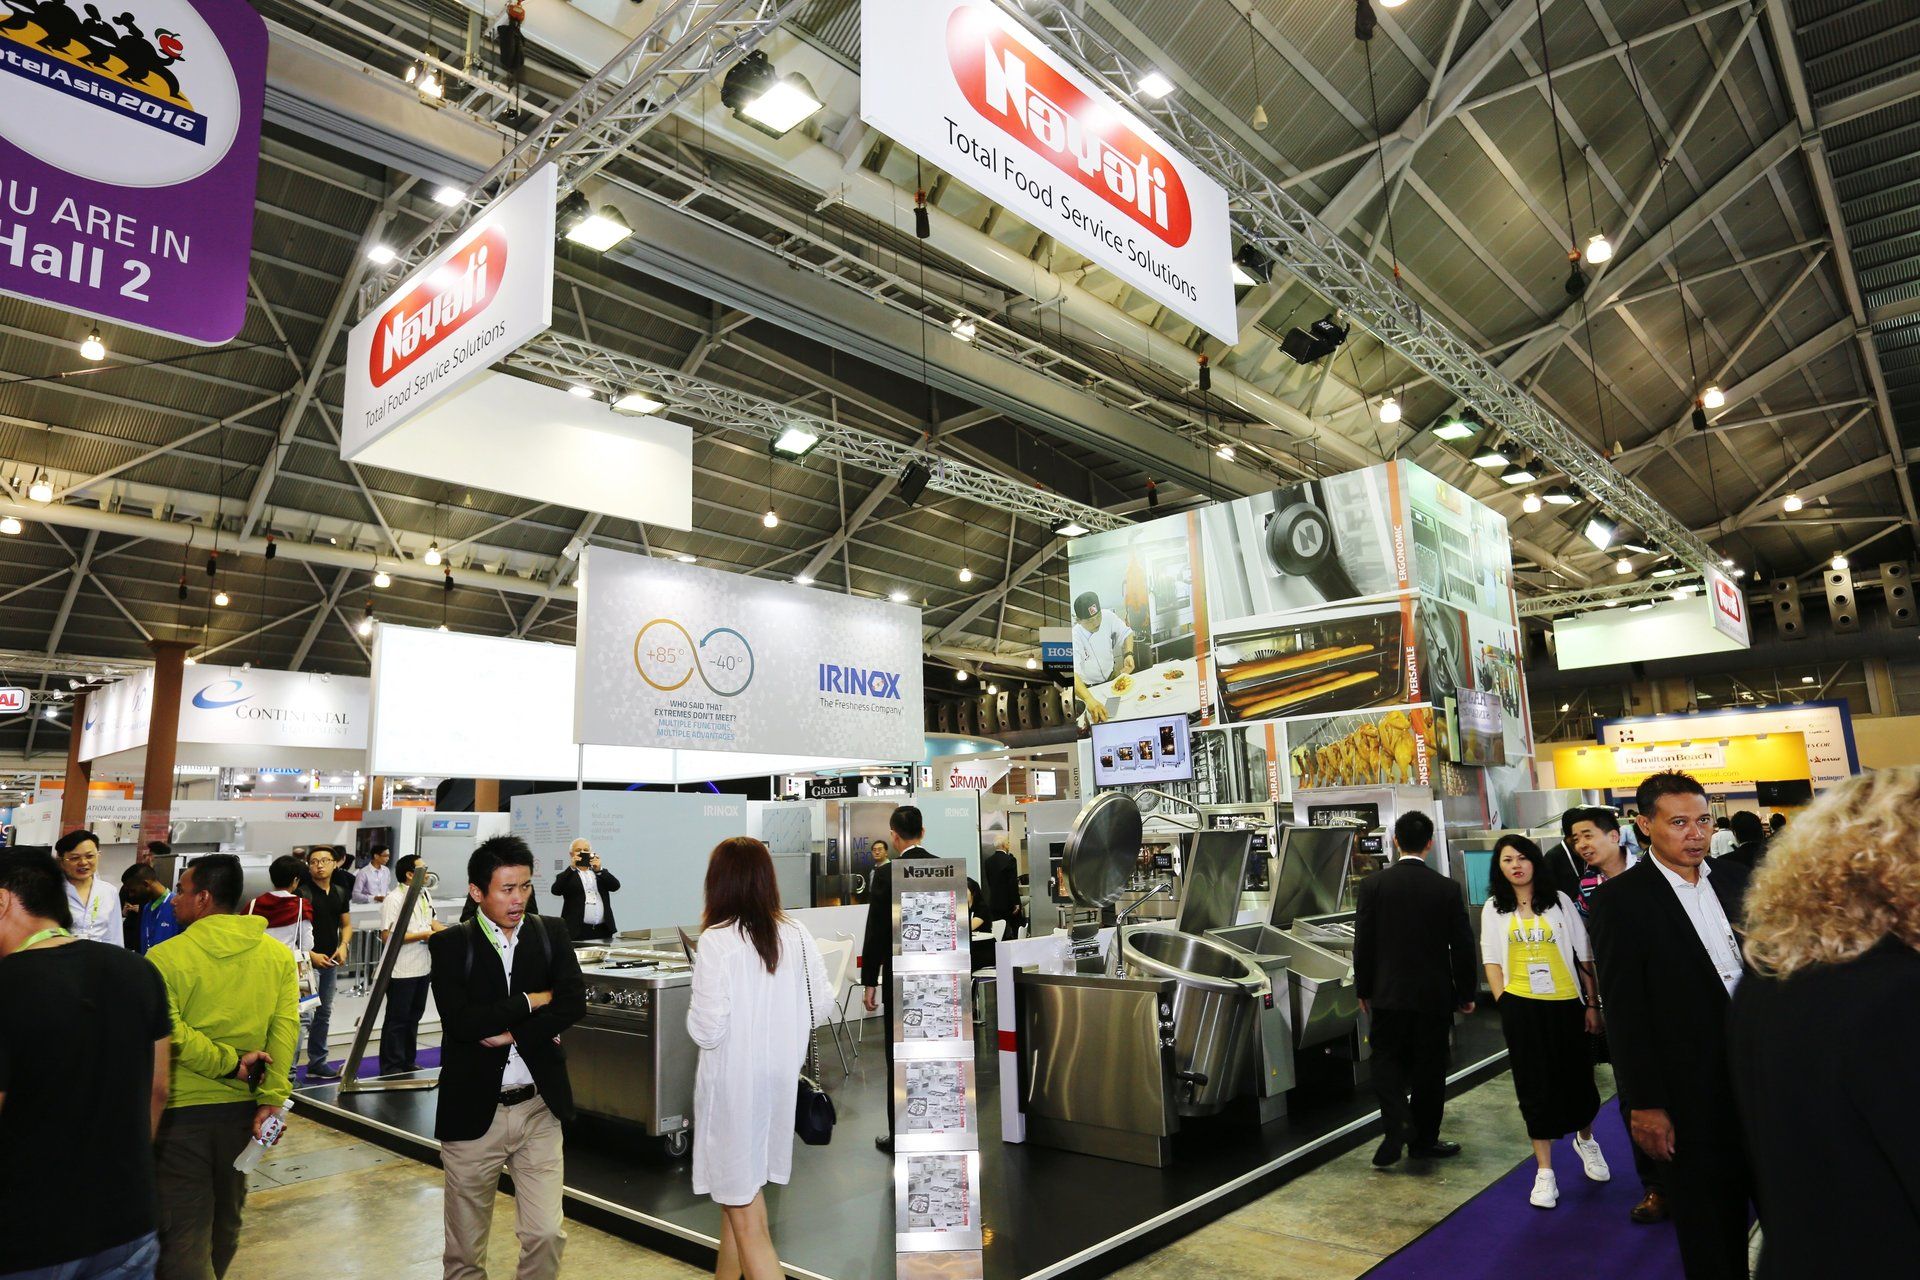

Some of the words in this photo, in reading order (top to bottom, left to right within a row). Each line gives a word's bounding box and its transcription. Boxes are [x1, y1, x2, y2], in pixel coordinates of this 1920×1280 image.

[0, 49, 196, 132] telAsia2016
[0, 178, 38, 215] U
[51, 197, 137, 247] ARE
[150, 225, 190, 264] IN
[944, 116, 996, 173] Total
[1004, 156, 1053, 209] Food
[1060, 195, 1123, 254] Service
[1127, 239, 1197, 302] Solutions
[0, 222, 104, 289] Hall
[119, 260, 151, 302] 2
[365, 404, 386, 429] Total
[388, 385, 411, 416] Food
[414, 360, 450, 396] Service
[452, 319, 506, 369] Solutions
[1394, 524, 1406, 581] ERGONOMIC
[1048, 647, 1073, 657] HOS
[819, 663, 901, 700] IRINOX
[1406, 645, 1420, 696] VERSATILE
[670, 700, 687, 709] WHO
[689, 702, 704, 710] SAID
[706, 703, 722, 711] THAT
[820, 698, 833, 708] The
[835, 700, 870, 712] Freshness
[1200, 679, 1209, 719] RELIABLE
[236, 705, 350, 725] CONTINENTAL
[655, 709, 691, 719] EXTREMES
[693, 712, 713, 720] DON'T
[715, 714, 737, 722] MEET?
[659, 719, 691, 728] MULTIPLE
[657, 728, 690, 738] MULTIPLE
[692, 731, 735, 741] ADVANTAGES
[1416, 734, 1428, 786] ONSISTENT
[811, 785, 848, 797] GIORIK
[950, 775, 988, 789] SIRMAN
[1268, 761, 1279, 802] DURABLE
[704, 805, 739, 817] IRINOX
[945, 807, 969, 817] IRINOX
